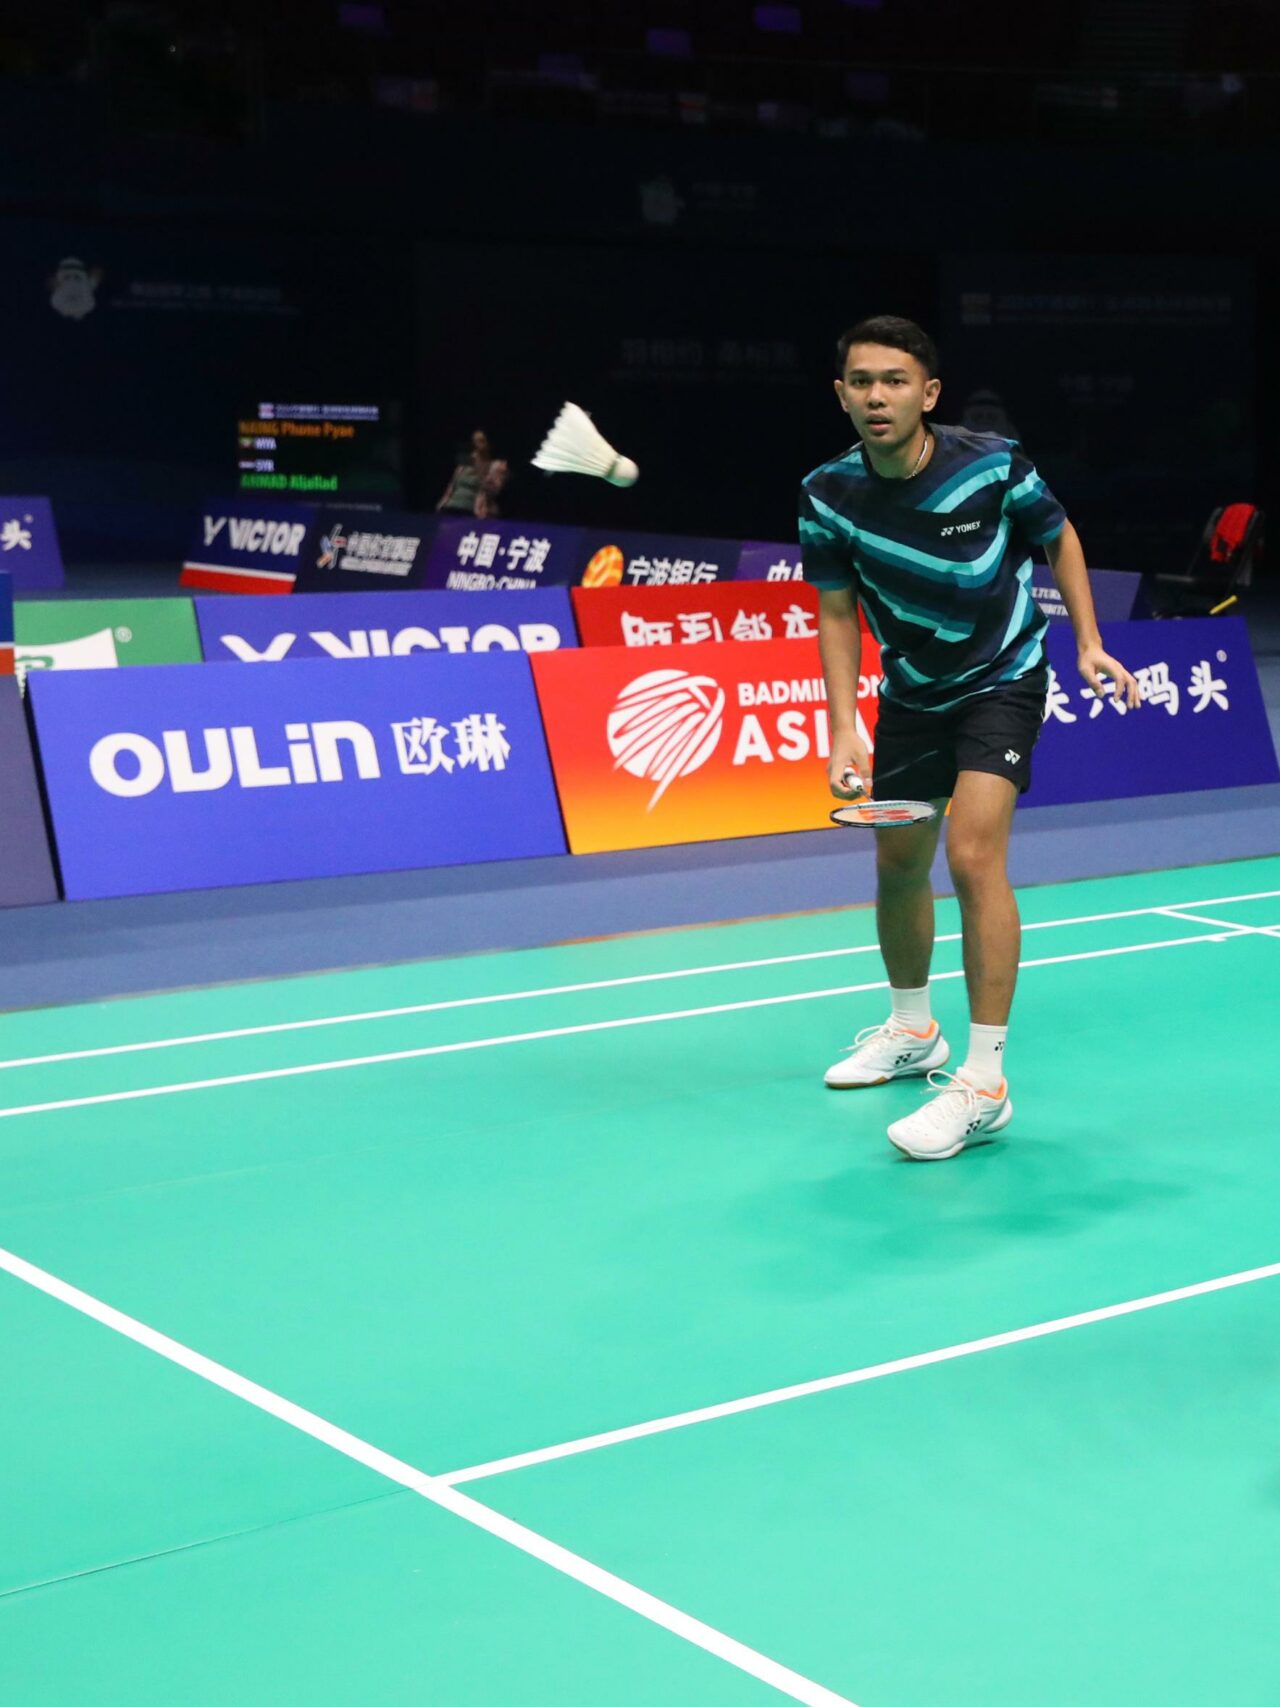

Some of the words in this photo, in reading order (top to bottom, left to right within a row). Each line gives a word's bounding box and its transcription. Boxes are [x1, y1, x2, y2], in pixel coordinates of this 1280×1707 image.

[229, 517, 306, 556] VICTOR
[955, 520, 981, 534] YONEX
[737, 674, 885, 706] BADMION
[390, 712, 512, 776] 欧琳
